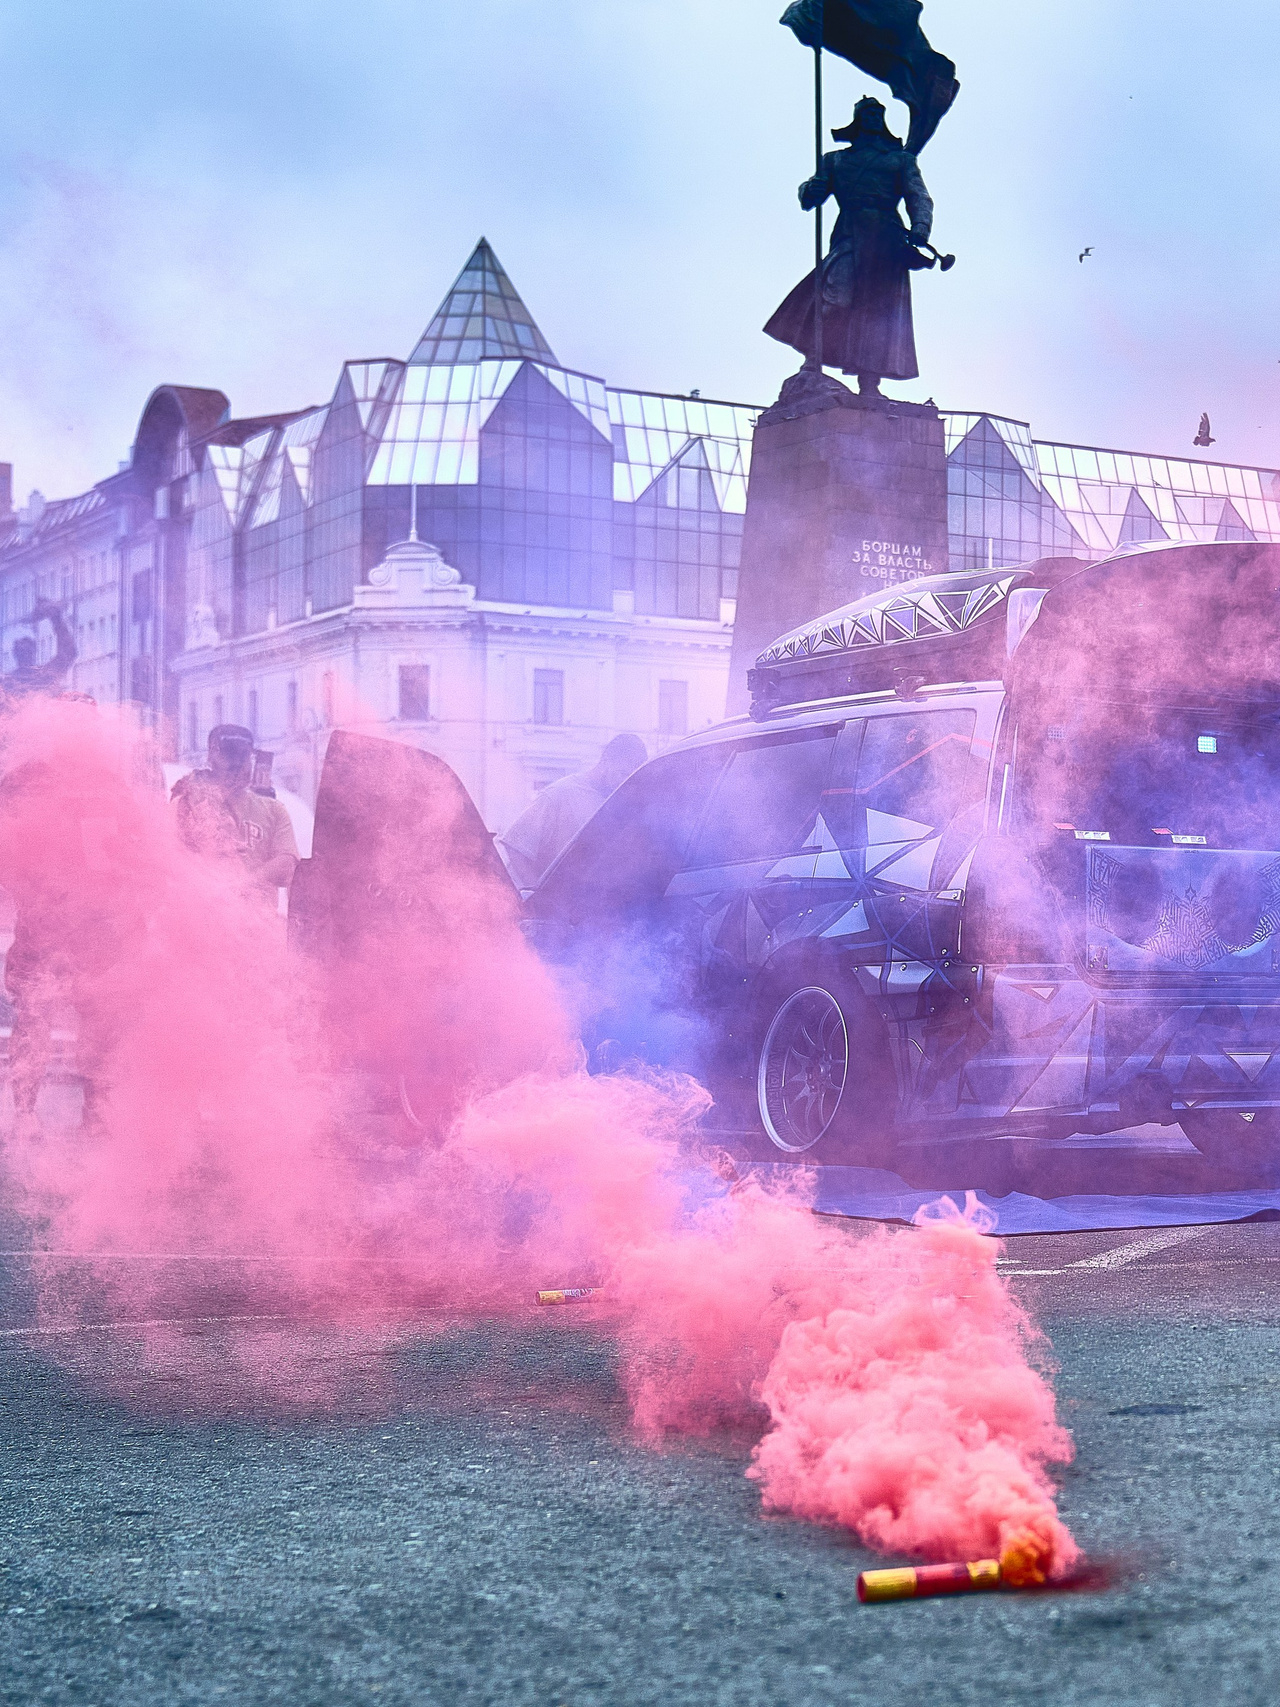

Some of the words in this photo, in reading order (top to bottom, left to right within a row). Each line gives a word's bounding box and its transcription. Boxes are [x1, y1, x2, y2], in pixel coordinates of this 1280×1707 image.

[862, 540, 922, 557] БОРЦАМ
[851, 550, 871, 564] ЗА
[878, 554, 932, 571] ВЛАСТЬ
